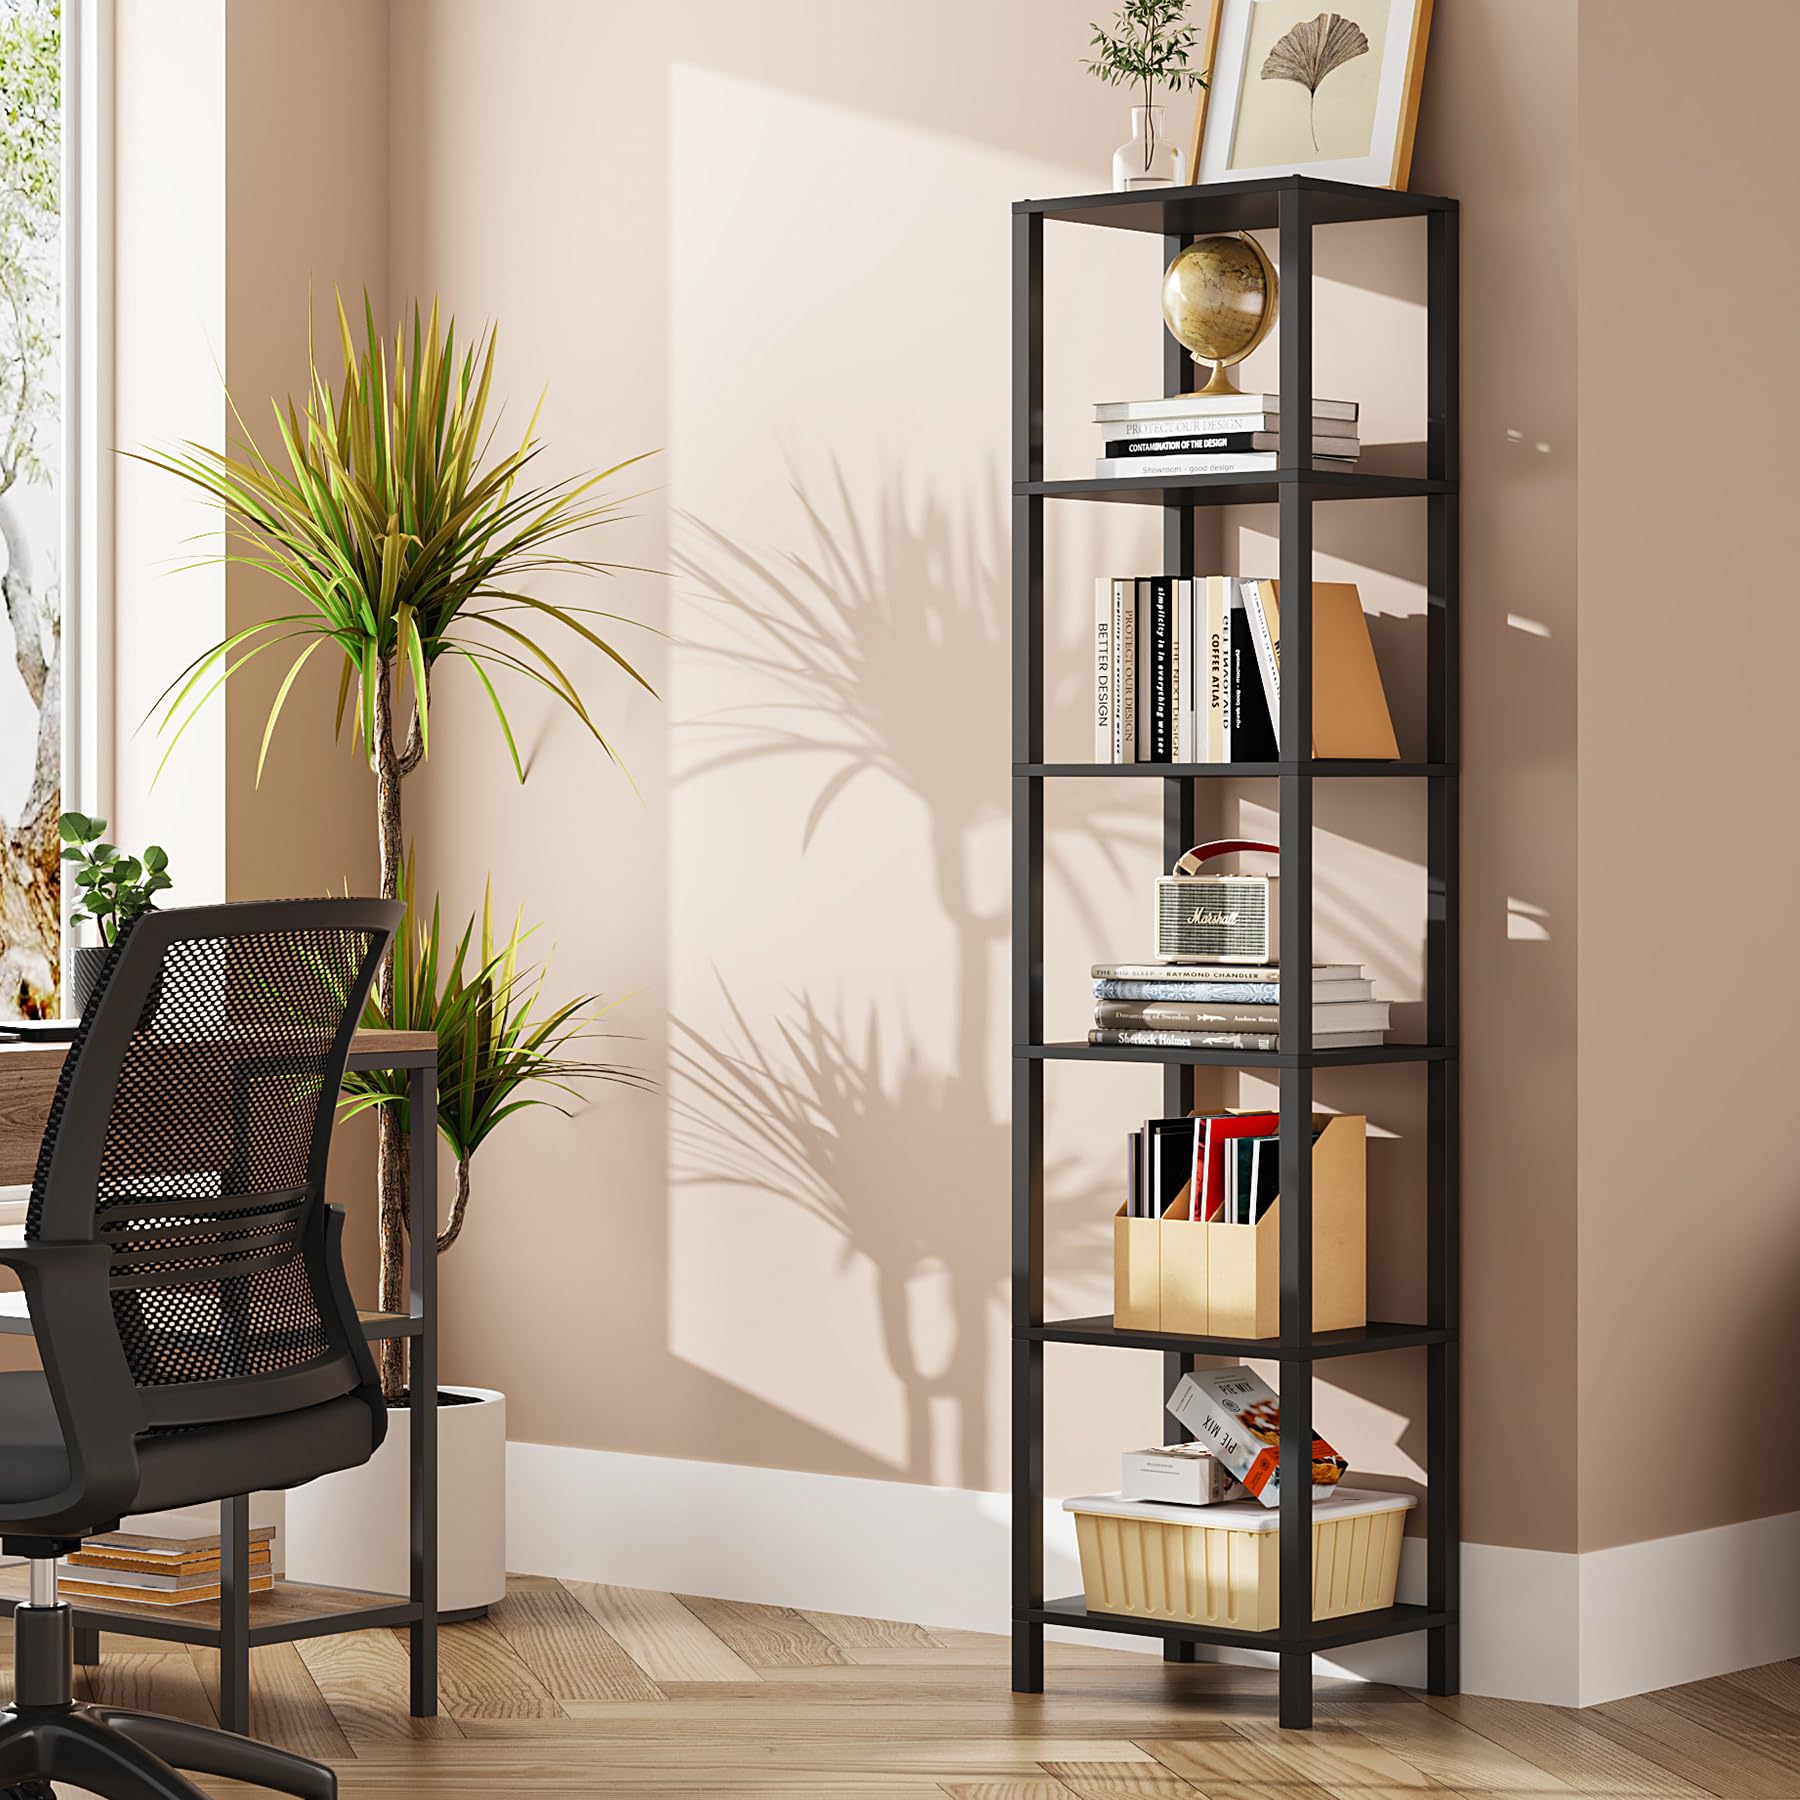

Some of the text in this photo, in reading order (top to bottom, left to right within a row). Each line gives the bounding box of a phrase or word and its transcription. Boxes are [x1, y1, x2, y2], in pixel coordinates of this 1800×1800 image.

[1126, 418, 1243, 435] PROTECT OUR DESIGN
[1181, 440, 1191, 449] OF
[1191, 439, 1203, 449] THE
[1204, 438, 1228, 448] DESIGN
[1142, 465, 1182, 474] Showroom
[1189, 465, 1208, 474] good
[1210, 463, 1234, 473] design
[1156, 587, 1166, 637] simplicity
[1158, 640, 1166, 649] is
[1158, 651, 1166, 662] in
[1098, 623, 1108, 727] BETTER DESIGN
[1125, 610, 1133, 742] PROTECT OUR DESIGN
[1211, 633, 1220, 708] COFFEE ATLAS
[1156, 665, 1166, 718] everything
[1158, 721, 1164, 735] we
[1187, 907, 1240, 926] Marshall
[1152, 1012, 1160, 1021] of
[1118, 1032, 1191, 1046] Sherlock Holmes
[1218, 1382, 1255, 1395] PIE MIX
[1202, 1415, 1238, 1454] PIE MIX
